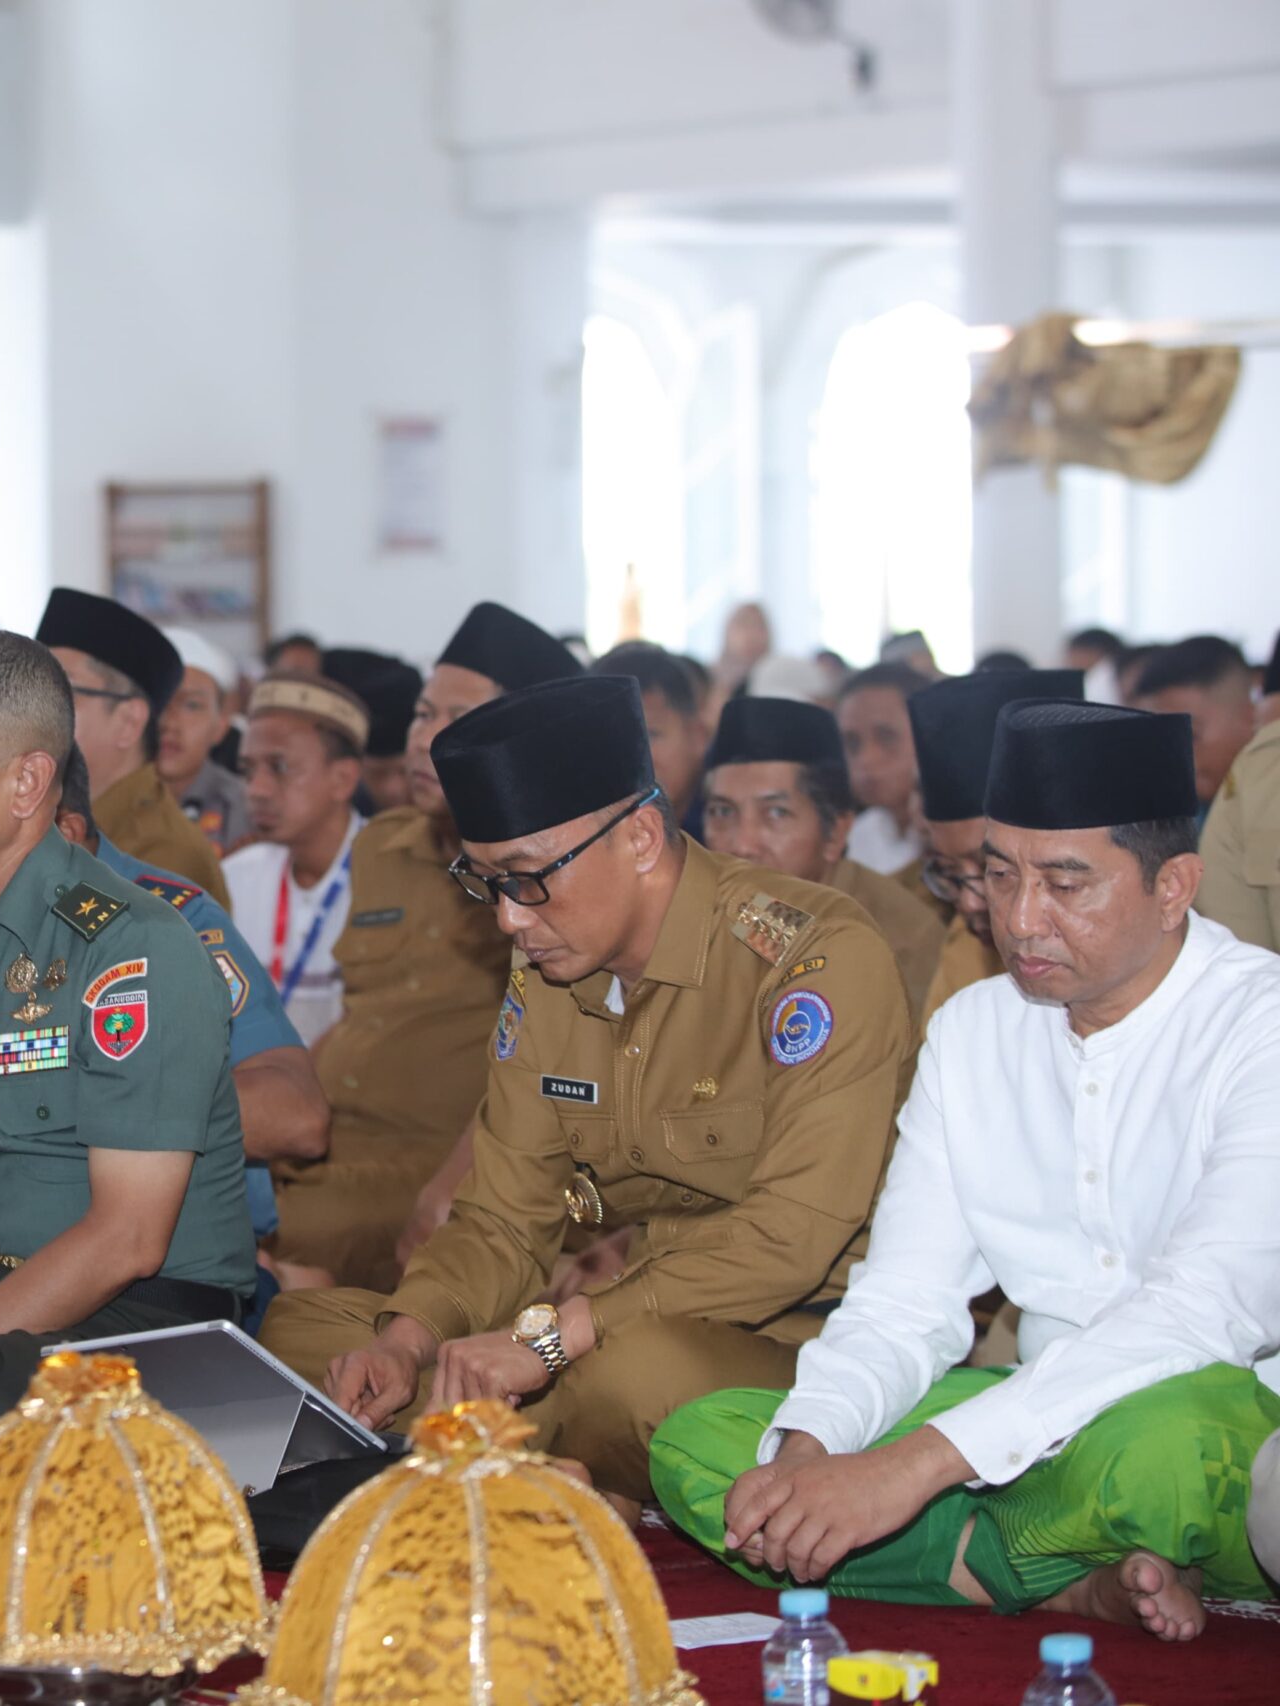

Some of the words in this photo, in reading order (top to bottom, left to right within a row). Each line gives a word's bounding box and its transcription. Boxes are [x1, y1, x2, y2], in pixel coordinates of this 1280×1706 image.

[87, 903, 118, 931] TNI
[126, 962, 145, 975] XIV
[785, 1038, 811, 1054] BNPP
[551, 1082, 586, 1097] ZUDAN
